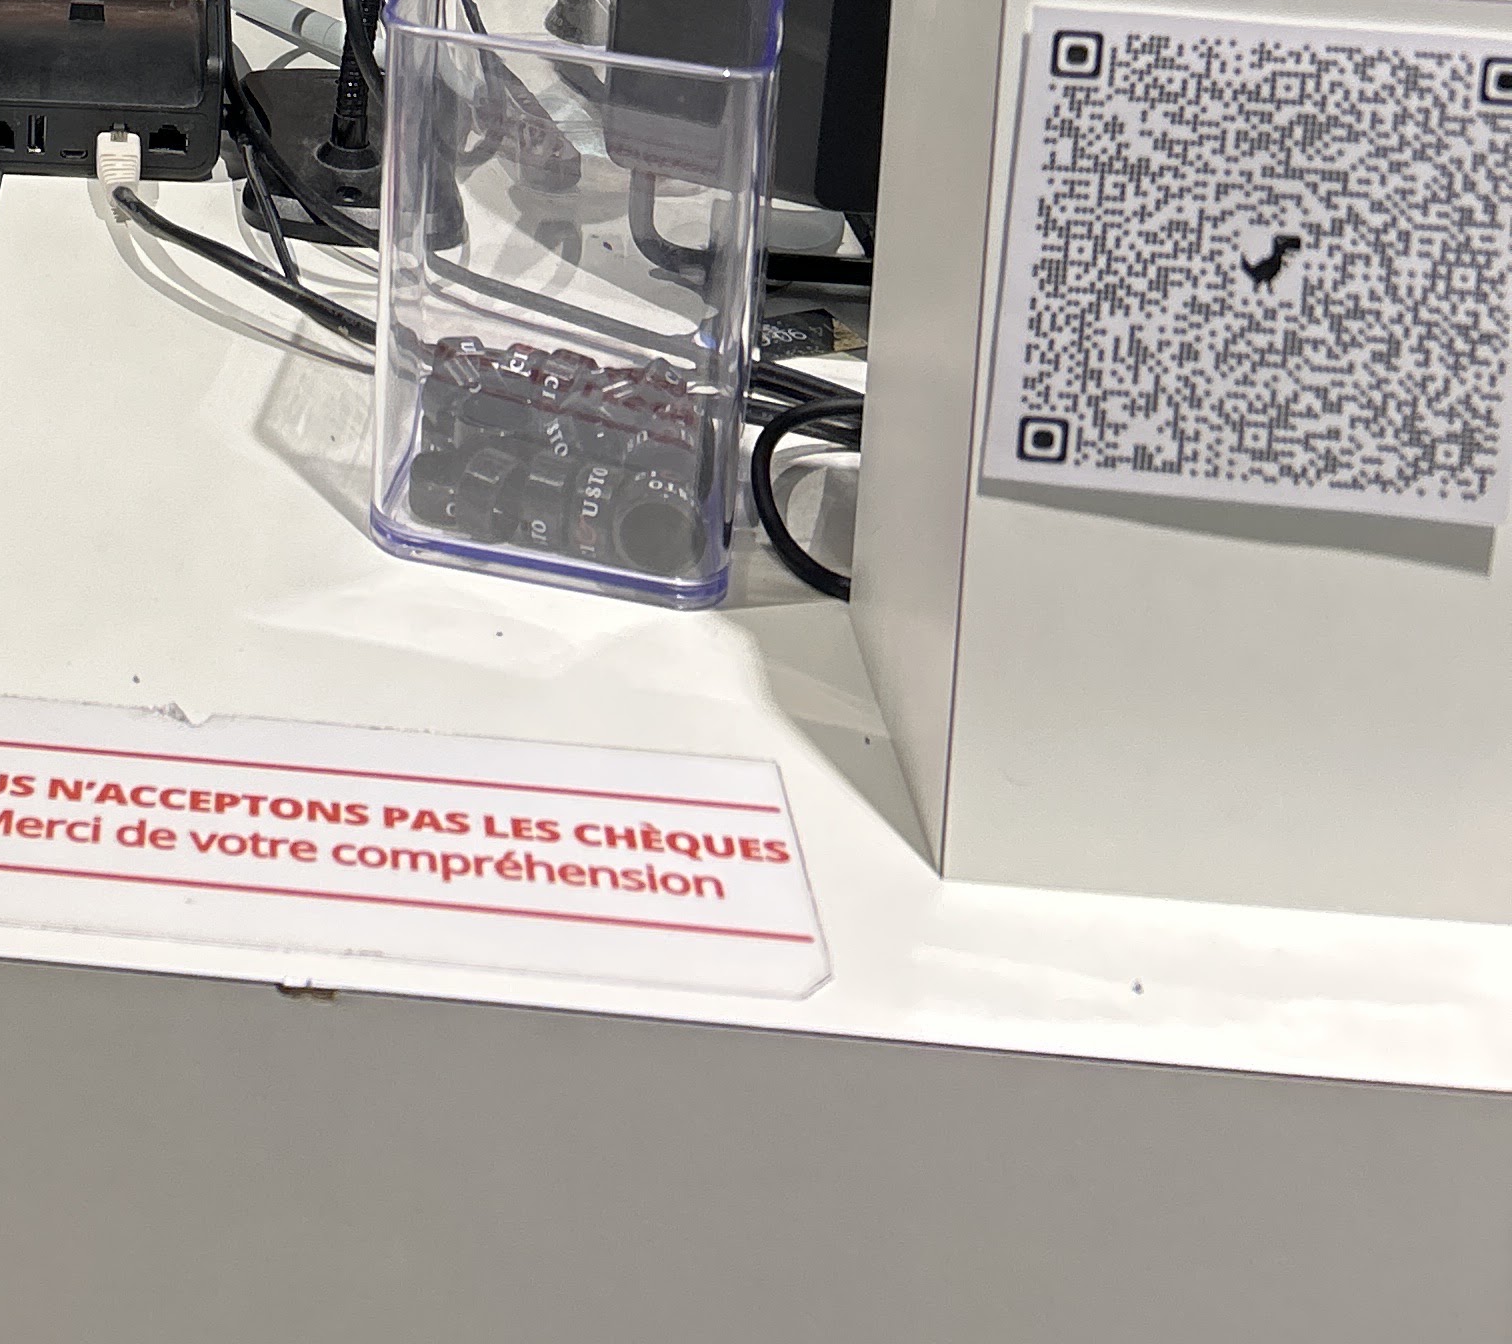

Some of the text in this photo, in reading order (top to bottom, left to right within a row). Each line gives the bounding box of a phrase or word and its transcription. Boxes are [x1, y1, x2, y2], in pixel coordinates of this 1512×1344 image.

[48, 776, 370, 828] N'ACCEPTONS
[383, 803, 471, 836] PAS
[483, 811, 562, 845] LES
[573, 817, 792, 867] CHÈQUES
[116, 813, 179, 851] de
[190, 827, 318, 865] votre
[331, 836, 726, 902] compréhension
